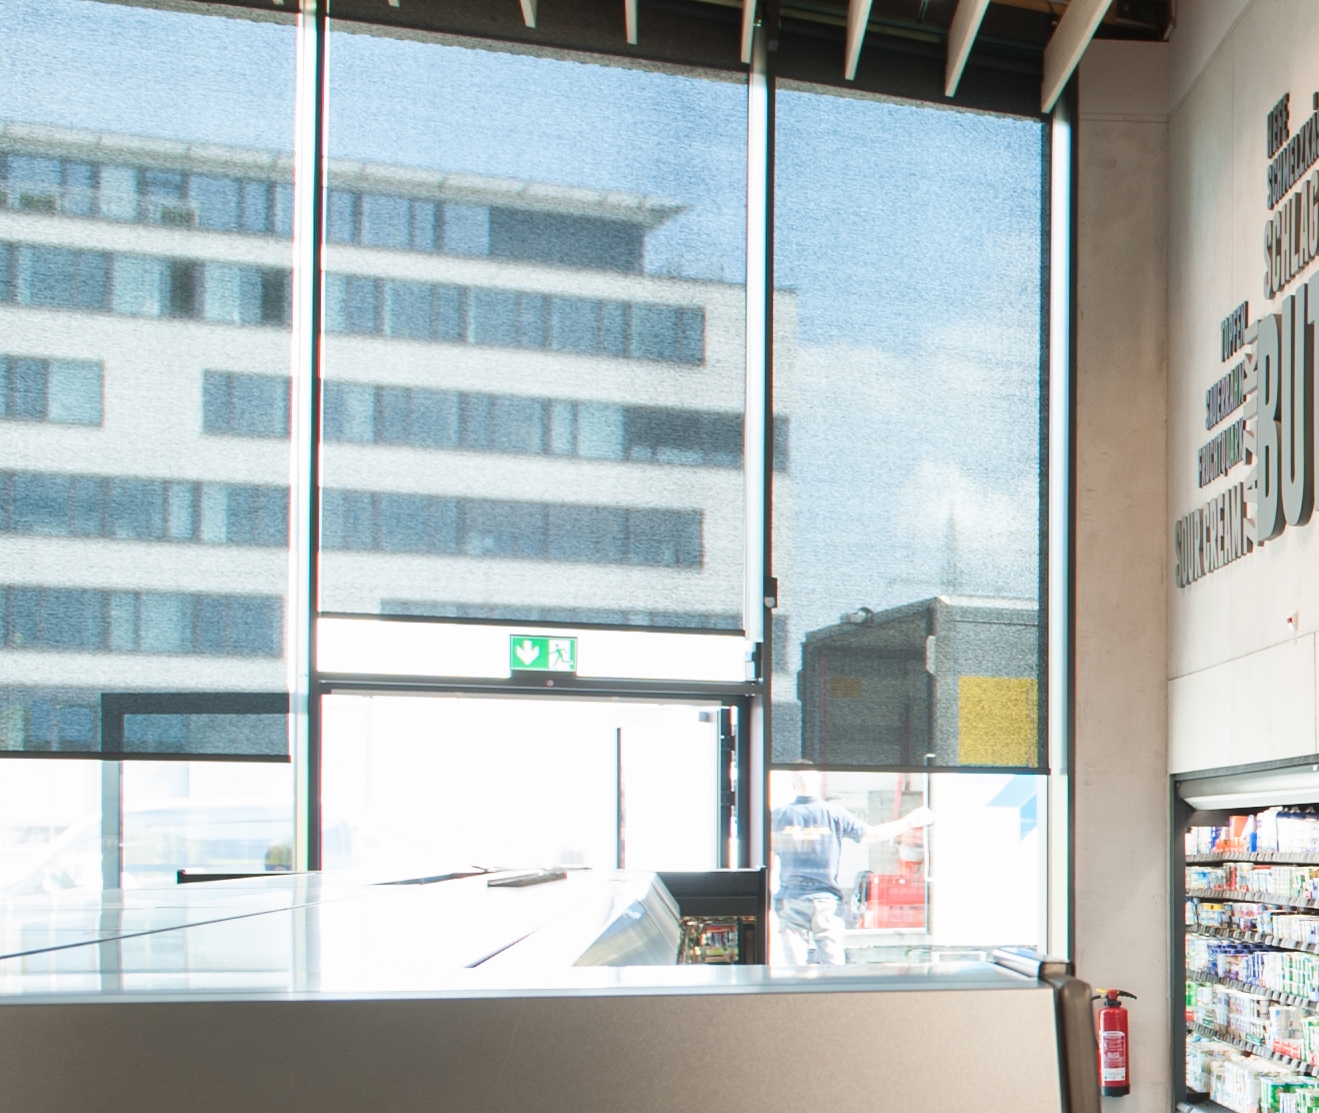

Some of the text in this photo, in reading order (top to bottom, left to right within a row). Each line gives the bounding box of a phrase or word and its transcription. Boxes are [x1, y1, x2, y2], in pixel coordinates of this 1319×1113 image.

[1267, 92, 1290, 159] HEFE
[1175, 482, 1248, 589] SOUR CREAM
